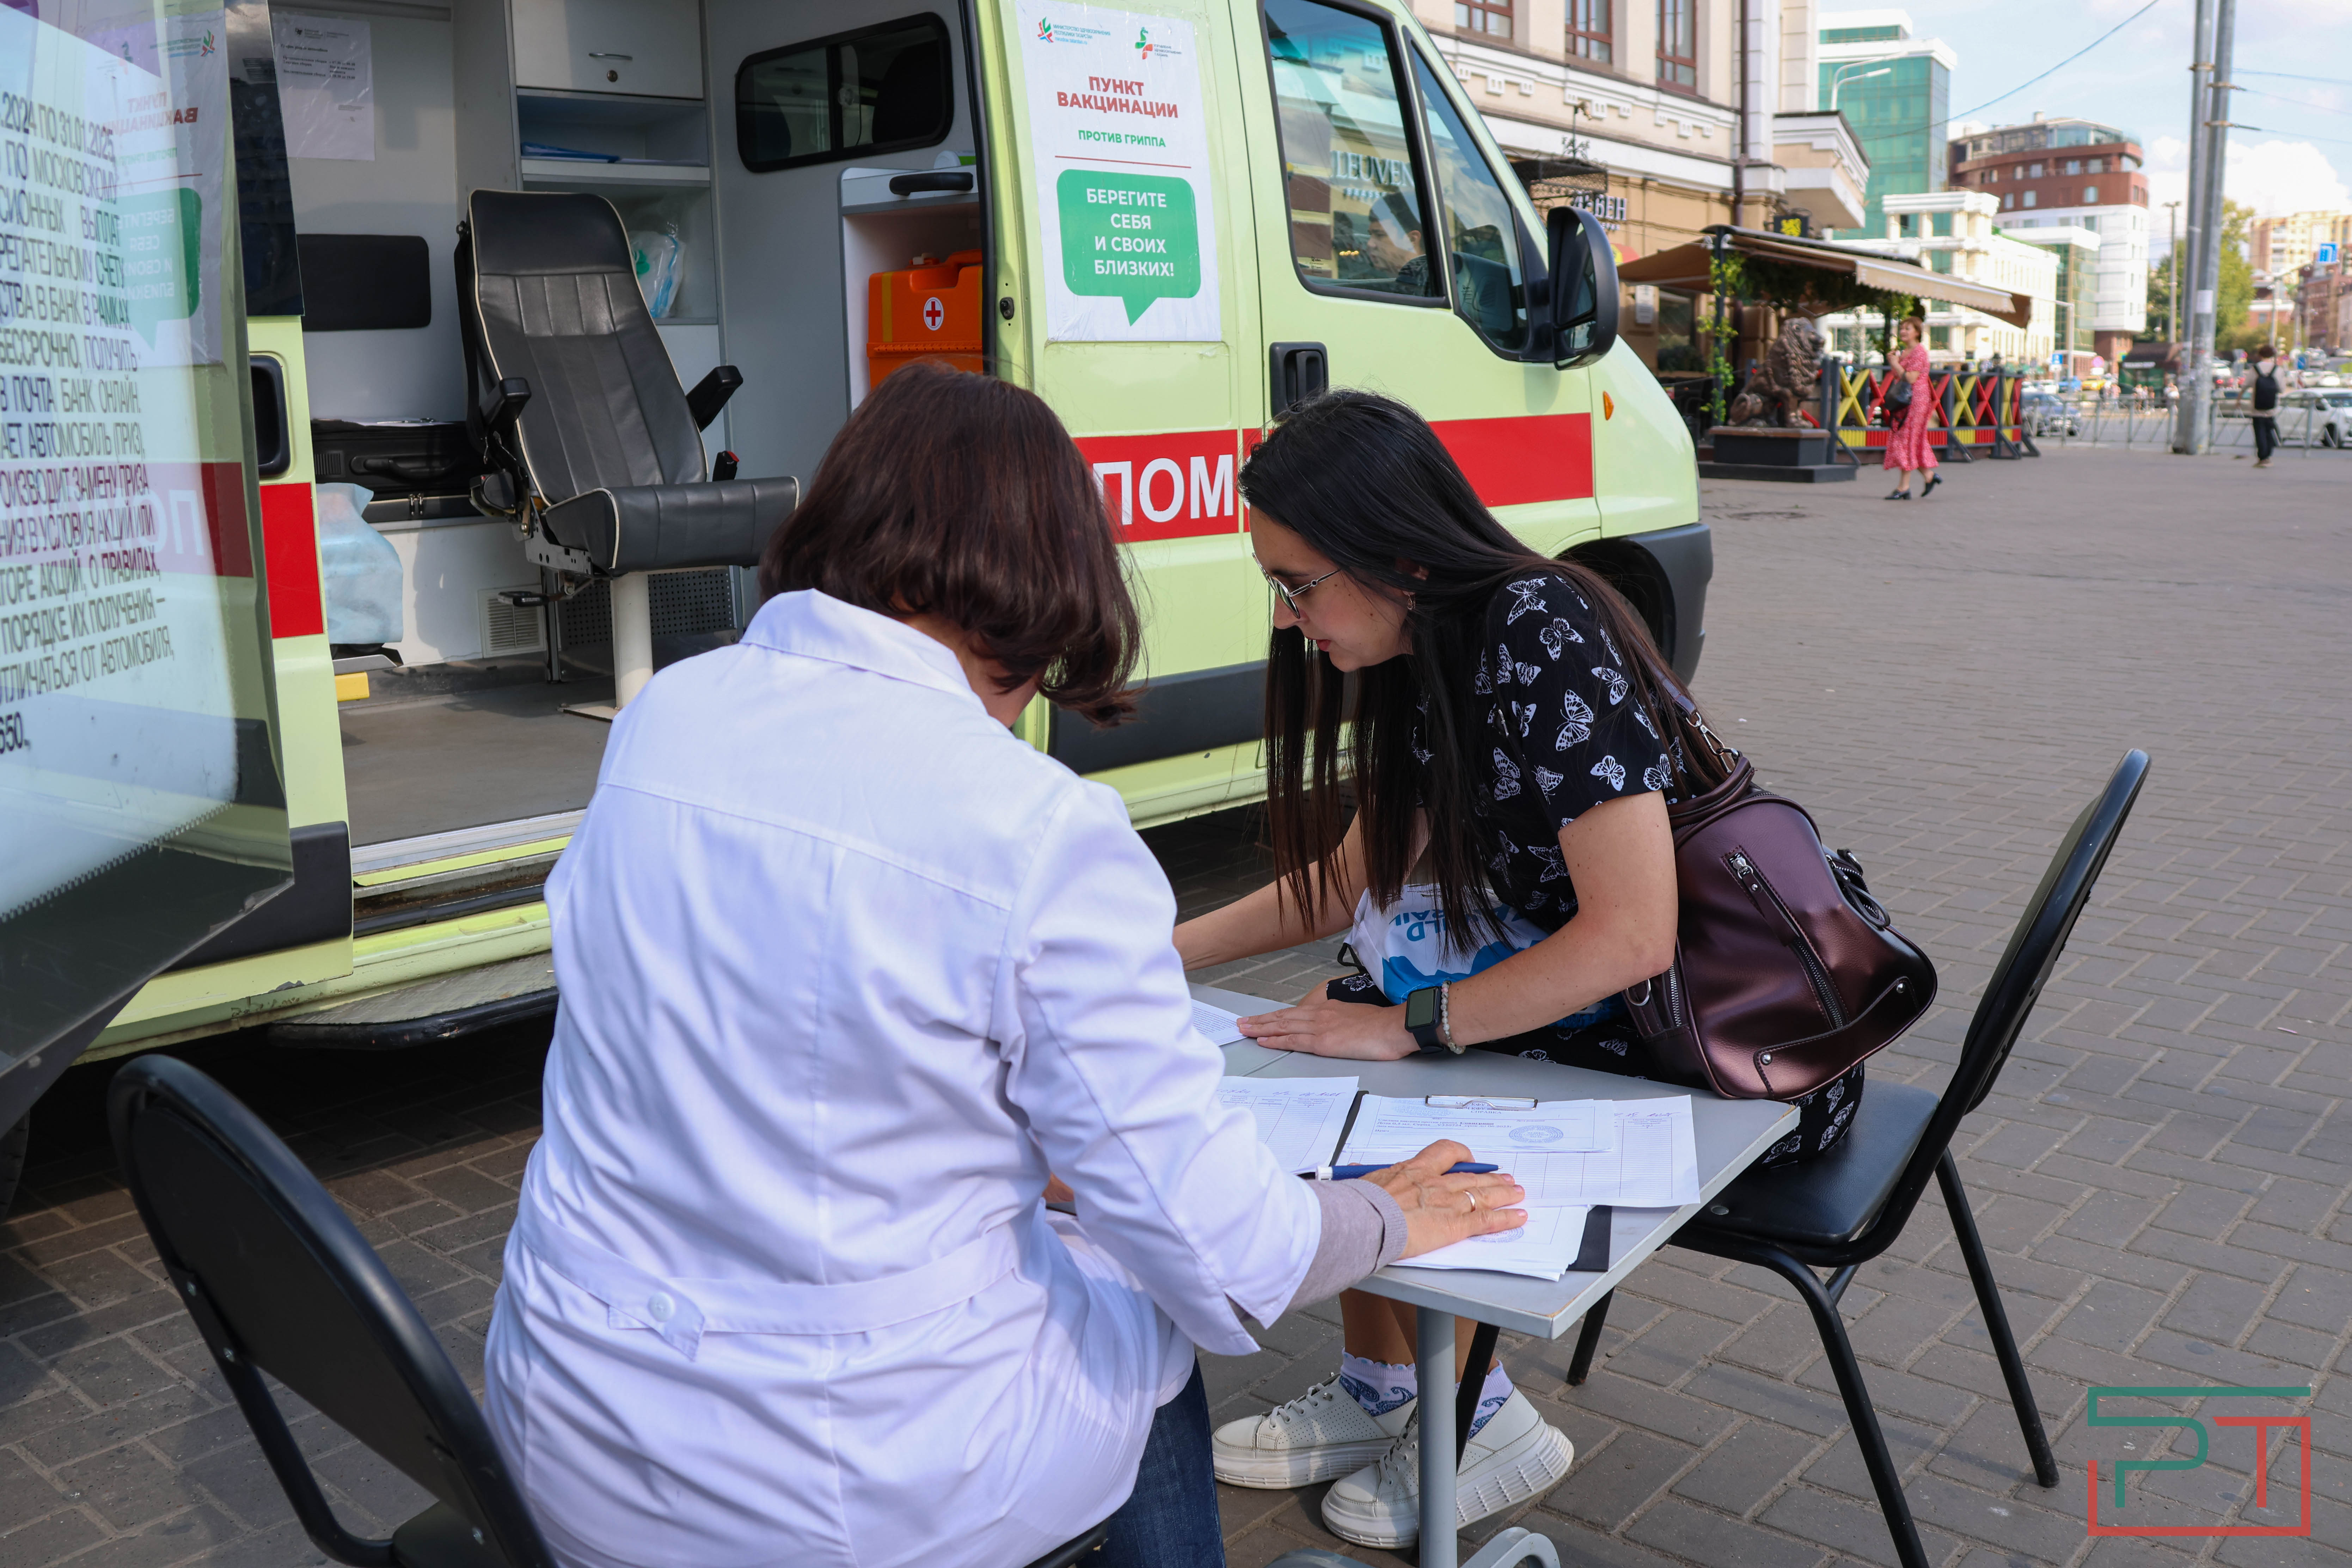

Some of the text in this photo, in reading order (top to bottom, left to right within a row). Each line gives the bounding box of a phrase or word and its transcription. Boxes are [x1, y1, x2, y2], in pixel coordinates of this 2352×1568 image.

[1056, 91, 1178, 118] ВАКЦИНАЦИИ
[1088, 76, 1144, 96] ПУНКТ
[37, 103, 57, 143] ПО
[1078, 129, 1166, 147] ПРОТИВ ГРИППА
[5, 139, 117, 205] ПО МОСКОВСКОМУ
[1086, 188, 1167, 208] БЕРЕГИТЕ
[79, 204, 120, 247] ВЫПЛАТ
[1110, 213, 1151, 229] СЕБЯ
[1095, 235, 1167, 253] И СВОИХ
[1094, 259, 1175, 277] БЛИЗКИХ!
[0, 280, 133, 331] СТВА В БАНК В РАМКАХ
[83, 334, 137, 373] ПОЛУЧИТЬ
[12, 375, 58, 413] ПОЧТА
[60, 378, 96, 413] БАНК
[28, 422, 111, 458] АВТОМОБИЛЬ
[72, 465, 117, 502] ЗАМЕНУ
[118, 463, 150, 498] ПРИЗА
[1092, 454, 1250, 526] ПОМ
[27, 517, 38, 553] В
[38, 510, 95, 551] УСЛОВИЯ
[97, 500, 134, 547] АКЦИЙ
[134, 504, 155, 538] ИЛИ
[89, 554, 99, 589] О
[101, 545, 161, 586] ПРАВИЛАХ,
[1, 606, 69, 654] ПОРЯДКЕ
[68, 601, 90, 638] ИХ
[87, 587, 157, 633] ПОЛУЧЕНИЯ
[0, 625, 174, 704] ТЛИЧАТЬСЯ ОТ АВТОМОБИЛЯ,
